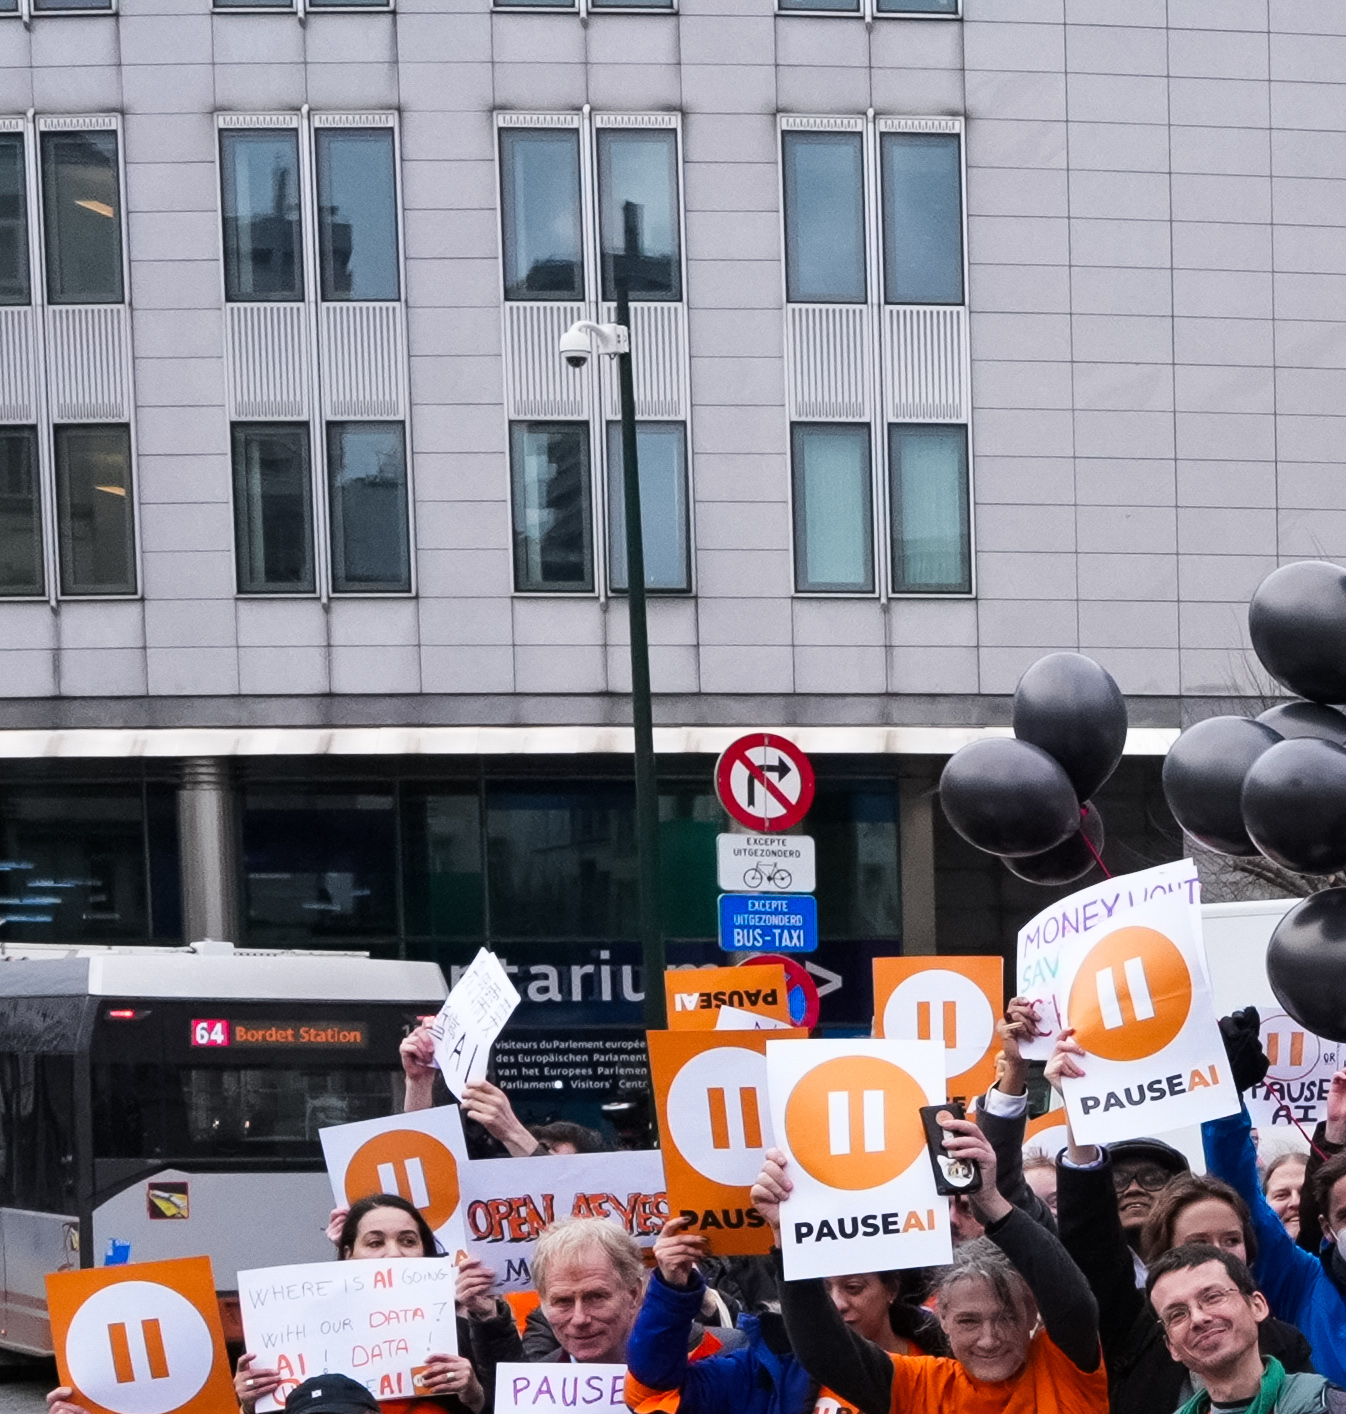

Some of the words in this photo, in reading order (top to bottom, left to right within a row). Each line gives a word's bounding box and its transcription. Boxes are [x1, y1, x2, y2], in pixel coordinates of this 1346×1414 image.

[733, 848, 801, 859] UITGEZONDERD
[746, 837, 787, 847] EXCEPTE
[747, 900, 788, 912] EXCEPTE
[733, 914, 803, 926] UITGEZONDERD
[1023, 892, 1121, 958] MONEY
[733, 928, 804, 948] BUS-TAXI
[674, 988, 778, 1012] PAUSEAI
[194, 1021, 227, 1046] 64
[235, 1026, 296, 1042] Bordet
[300, 1026, 362, 1043] Station
[495, 1039, 538, 1050] visiteurs
[540, 1039, 553, 1050] du
[553, 1039, 604, 1050] Parlement
[496, 1053, 513, 1063] des
[518, 1052, 589, 1064] Europäischen
[593, 1053, 648, 1063] Parlament
[498, 1067, 518, 1076] van
[522, 1066, 540, 1076] het
[544, 1066, 593, 1078] Europees
[597, 1066, 648, 1076] Parlemen
[1079, 1064, 1220, 1116] PAUSEAI
[1271, 1104, 1318, 1126] AI
[467, 1192, 556, 1242] OPEN
[793, 1207, 936, 1245] PAUSEAI
[249, 1280, 334, 1309] WHERE
[344, 1275, 365, 1295] IS
[373, 1267, 394, 1290] AI
[320, 1317, 354, 1336] OUR
[369, 1307, 426, 1329] DATA
[351, 1338, 410, 1368] DATA
[512, 1374, 626, 1408] PAUSE
